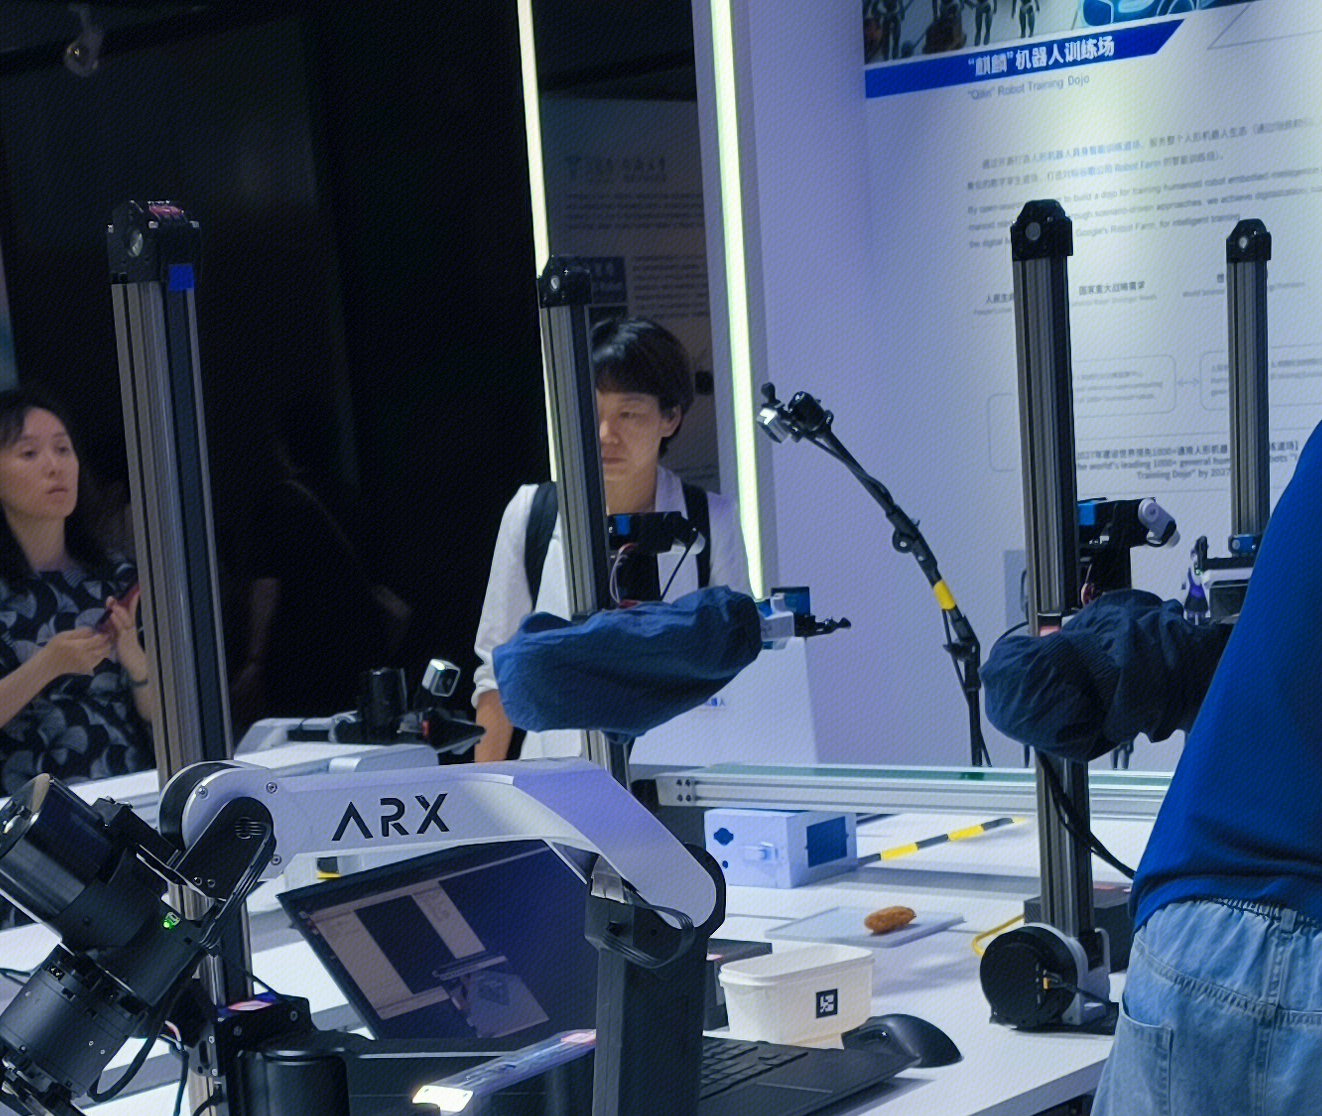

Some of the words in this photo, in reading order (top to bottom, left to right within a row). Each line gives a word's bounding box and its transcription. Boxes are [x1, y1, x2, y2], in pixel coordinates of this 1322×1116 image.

[998, 81, 1025, 96] Robot
[1028, 78, 1063, 93] Training
[1067, 73, 1090, 87] Dojo
[331, 792, 450, 841] ARX
